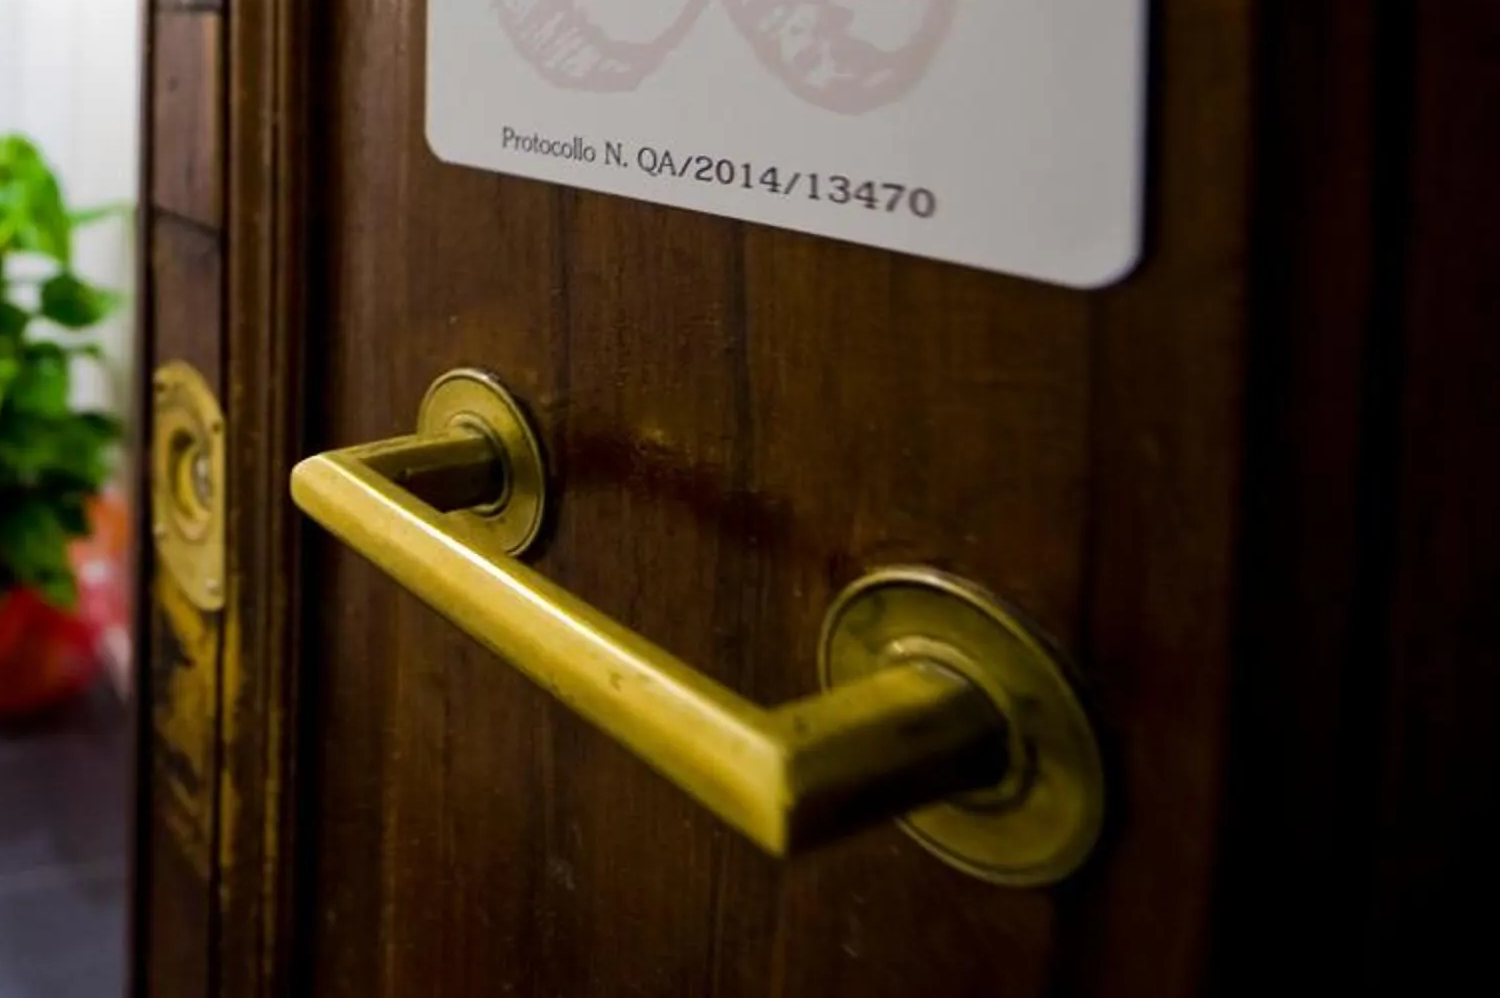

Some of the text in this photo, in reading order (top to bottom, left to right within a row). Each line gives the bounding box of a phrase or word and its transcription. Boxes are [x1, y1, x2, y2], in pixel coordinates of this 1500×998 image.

[501, 125, 937, 219] Protocollo N. QA/2014/13470
